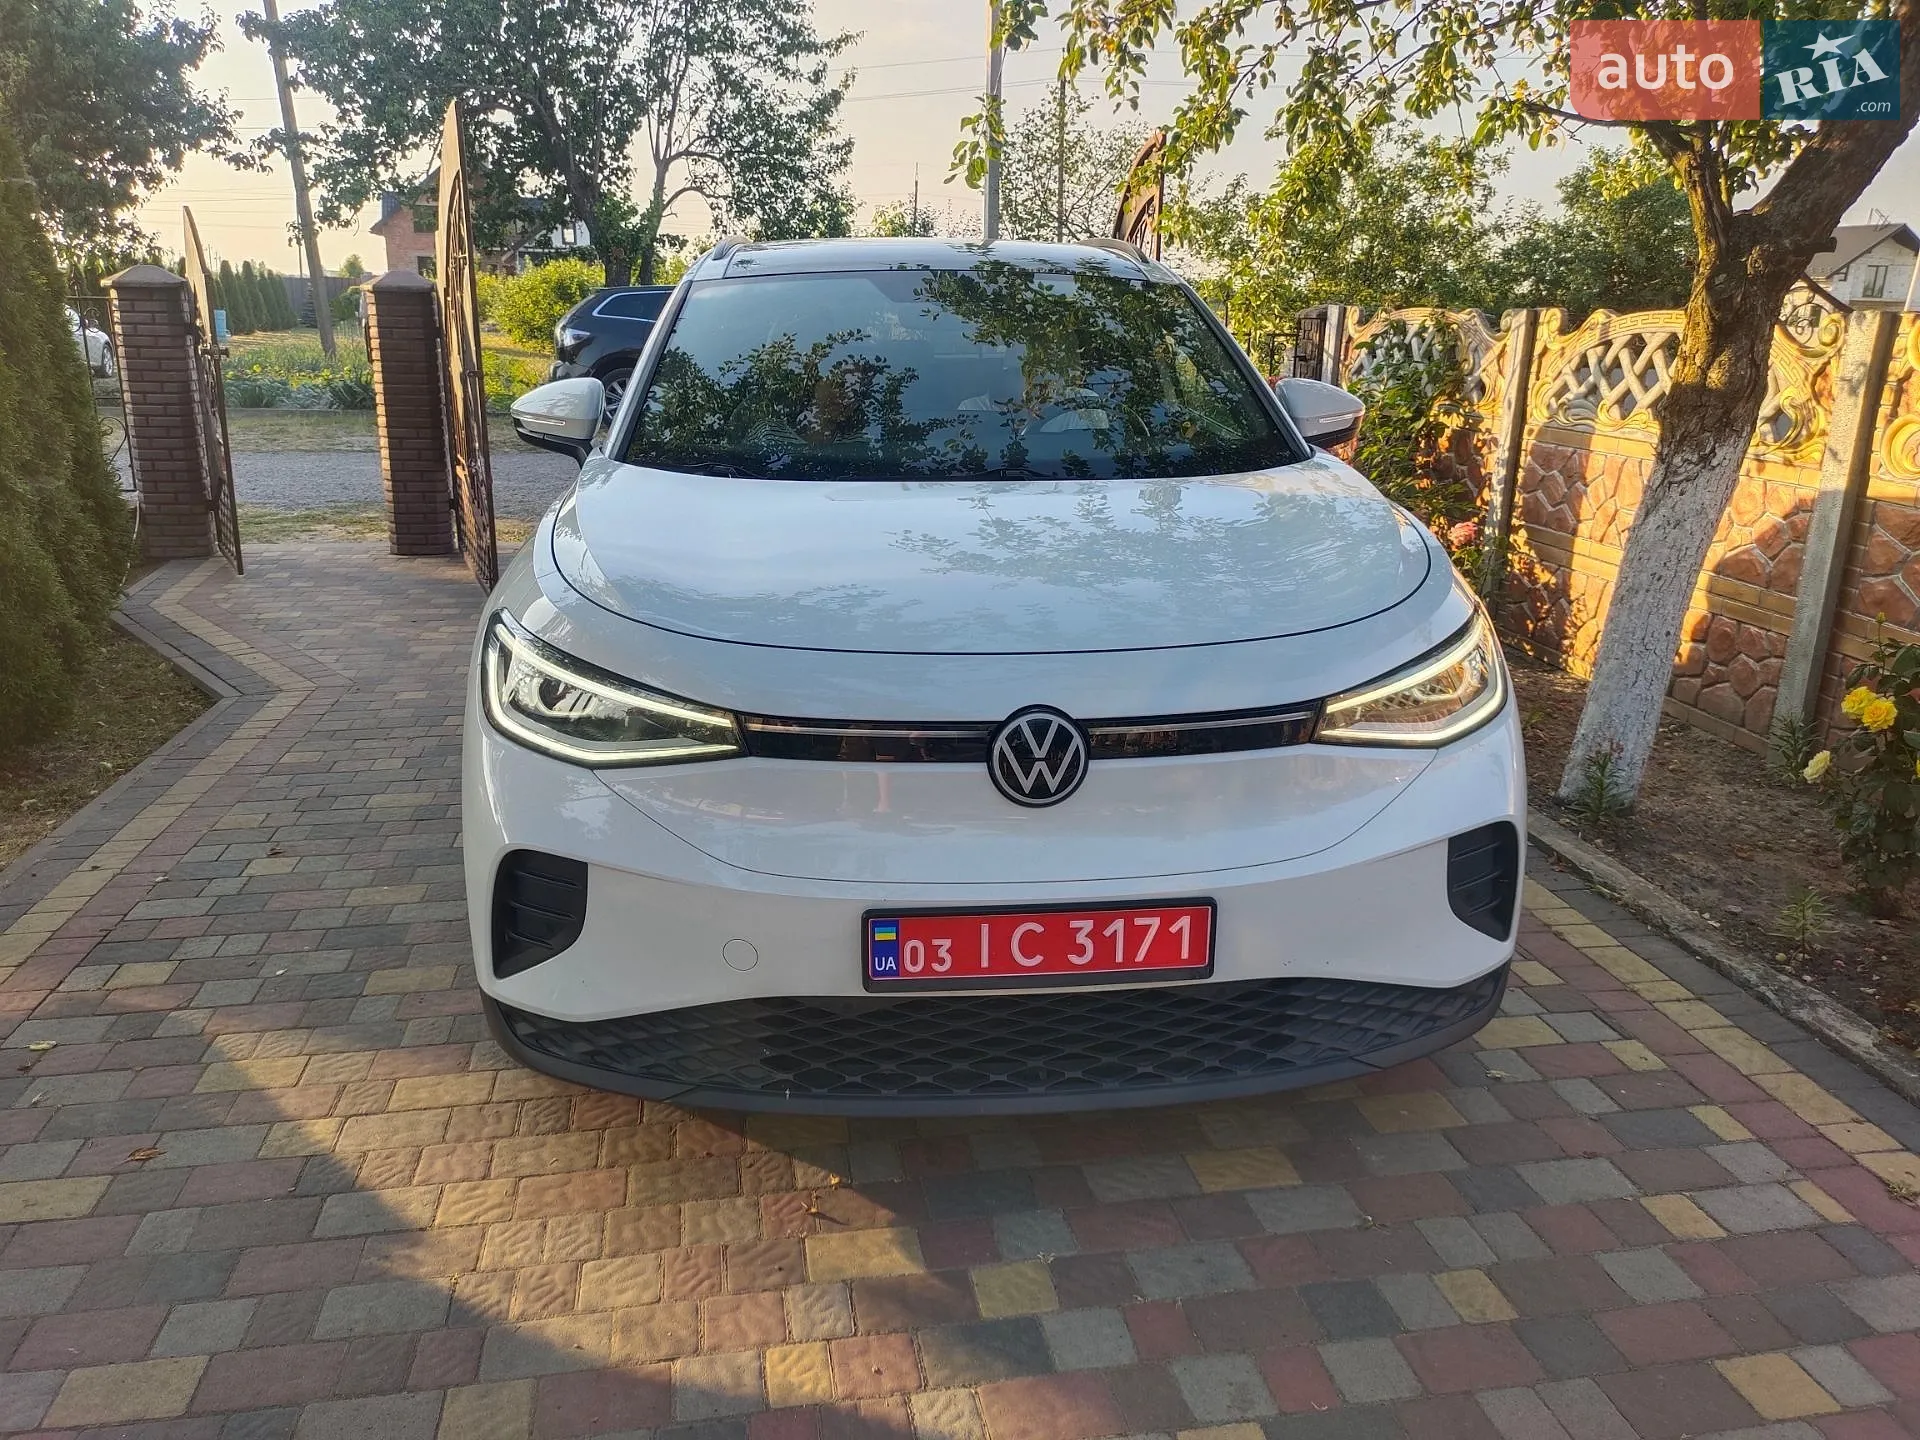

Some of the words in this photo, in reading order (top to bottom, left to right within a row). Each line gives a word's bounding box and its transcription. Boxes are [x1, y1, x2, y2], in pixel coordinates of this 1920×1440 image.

[903, 939, 952, 973] 03
[1066, 915, 1191, 965] 3171
[874, 956, 897, 972] UA
